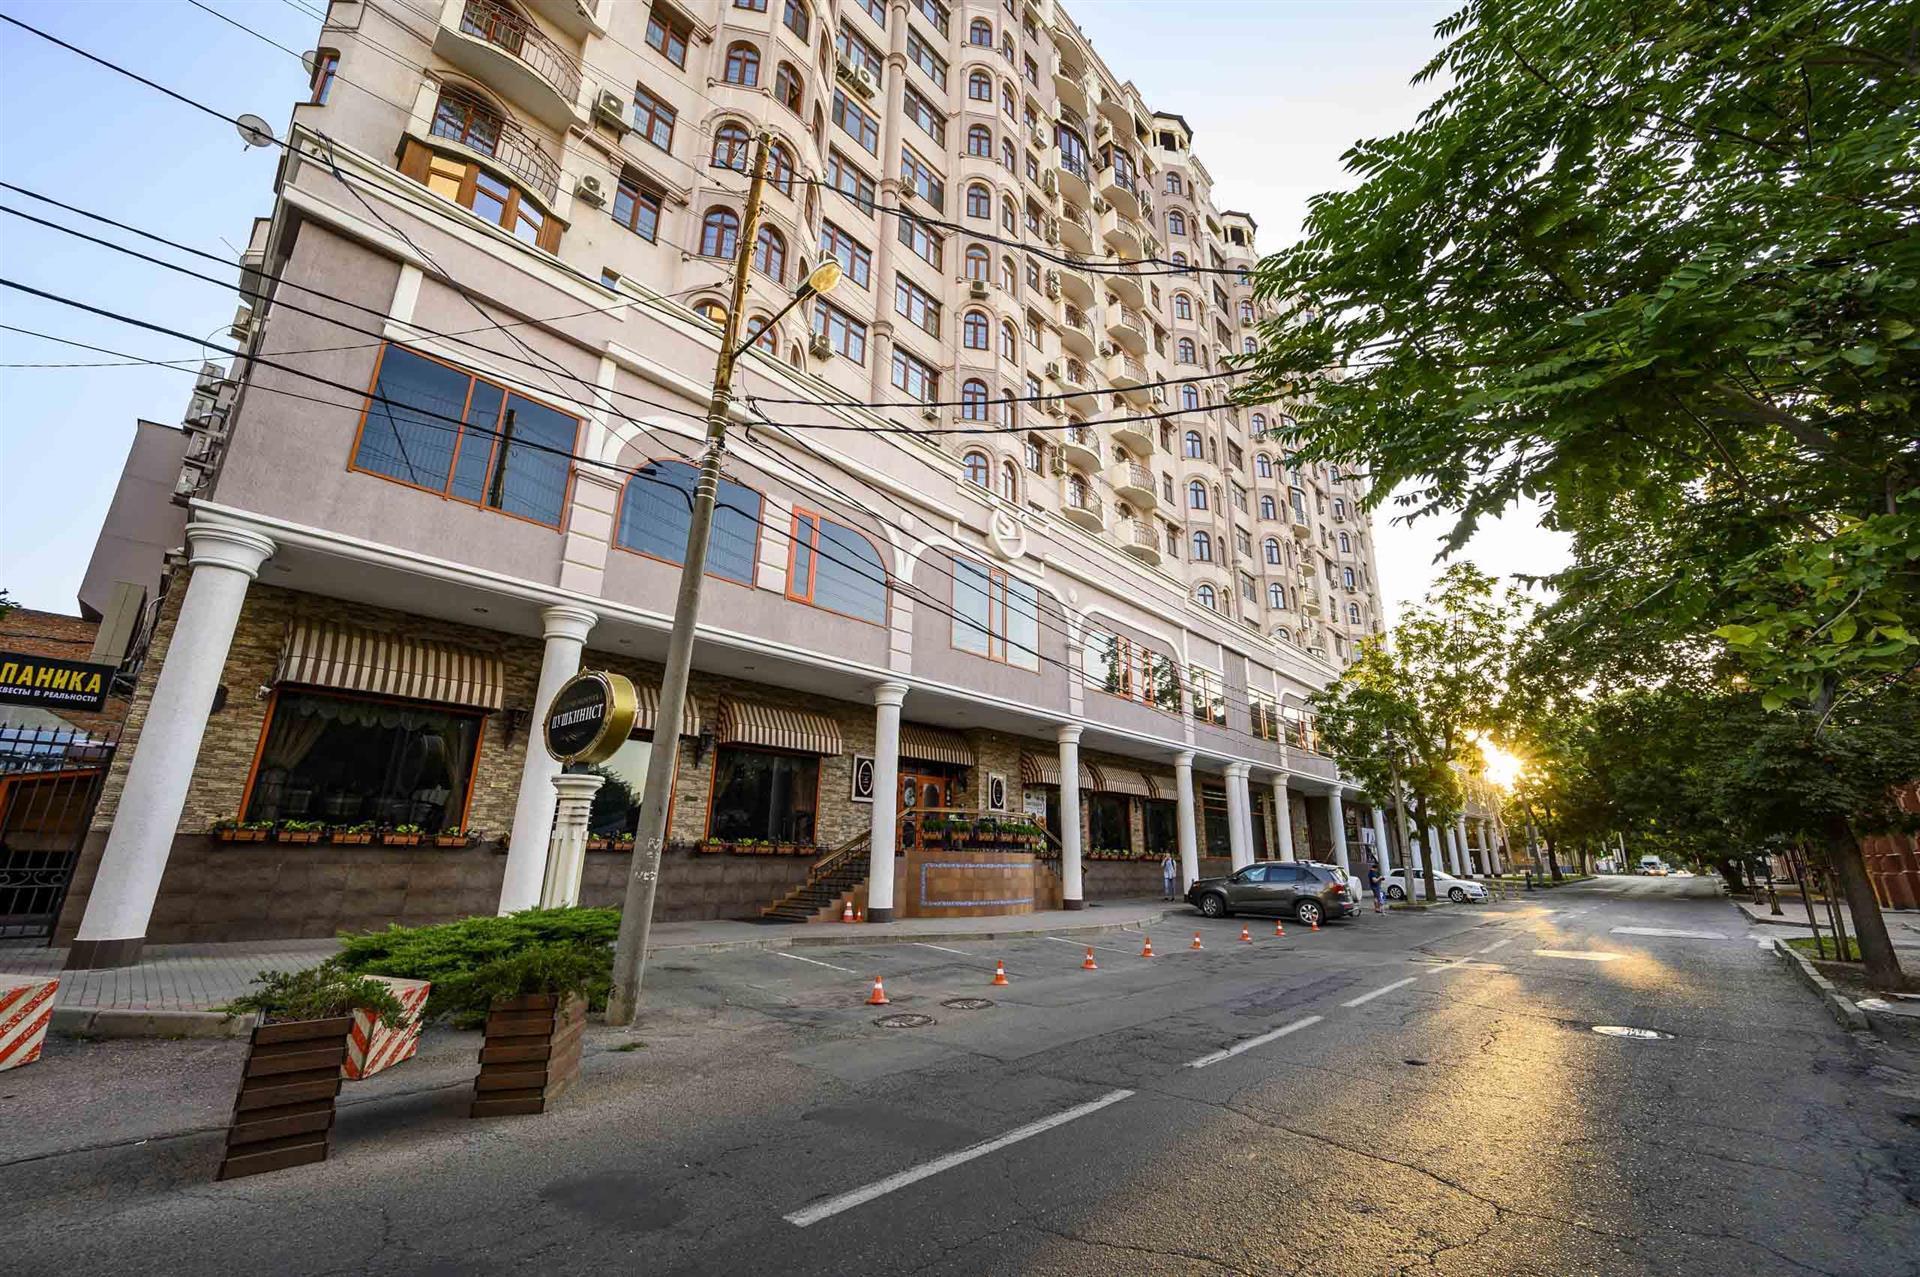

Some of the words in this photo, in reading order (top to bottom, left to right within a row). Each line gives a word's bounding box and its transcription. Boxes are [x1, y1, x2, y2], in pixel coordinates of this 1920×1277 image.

[0, 662, 101, 693] ПАНИКА
[43, 691, 98, 702] РЕАЛЬНОСТИ
[551, 703, 604, 730] ПУШКИНИСТ
